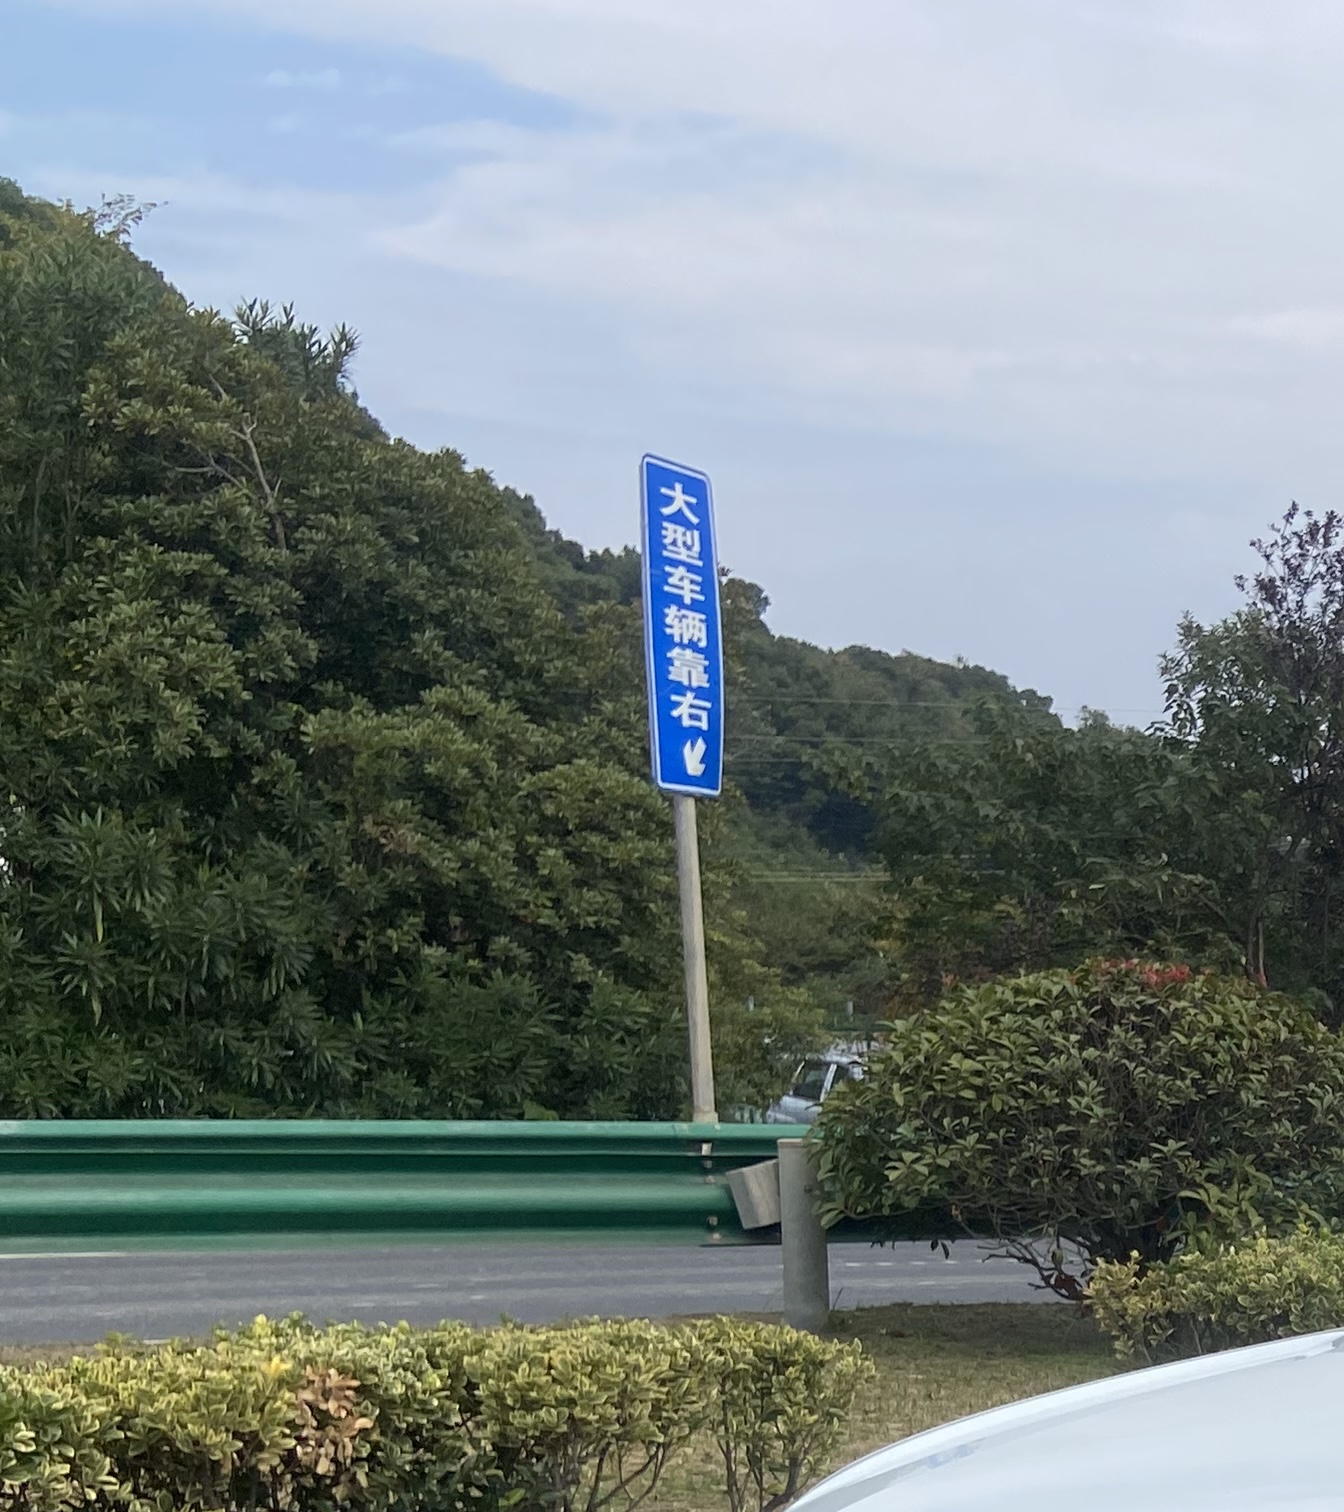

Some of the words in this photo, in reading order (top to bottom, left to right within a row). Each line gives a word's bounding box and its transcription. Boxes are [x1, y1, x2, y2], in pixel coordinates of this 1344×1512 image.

[659, 481, 710, 732] 大型车辆靠右
